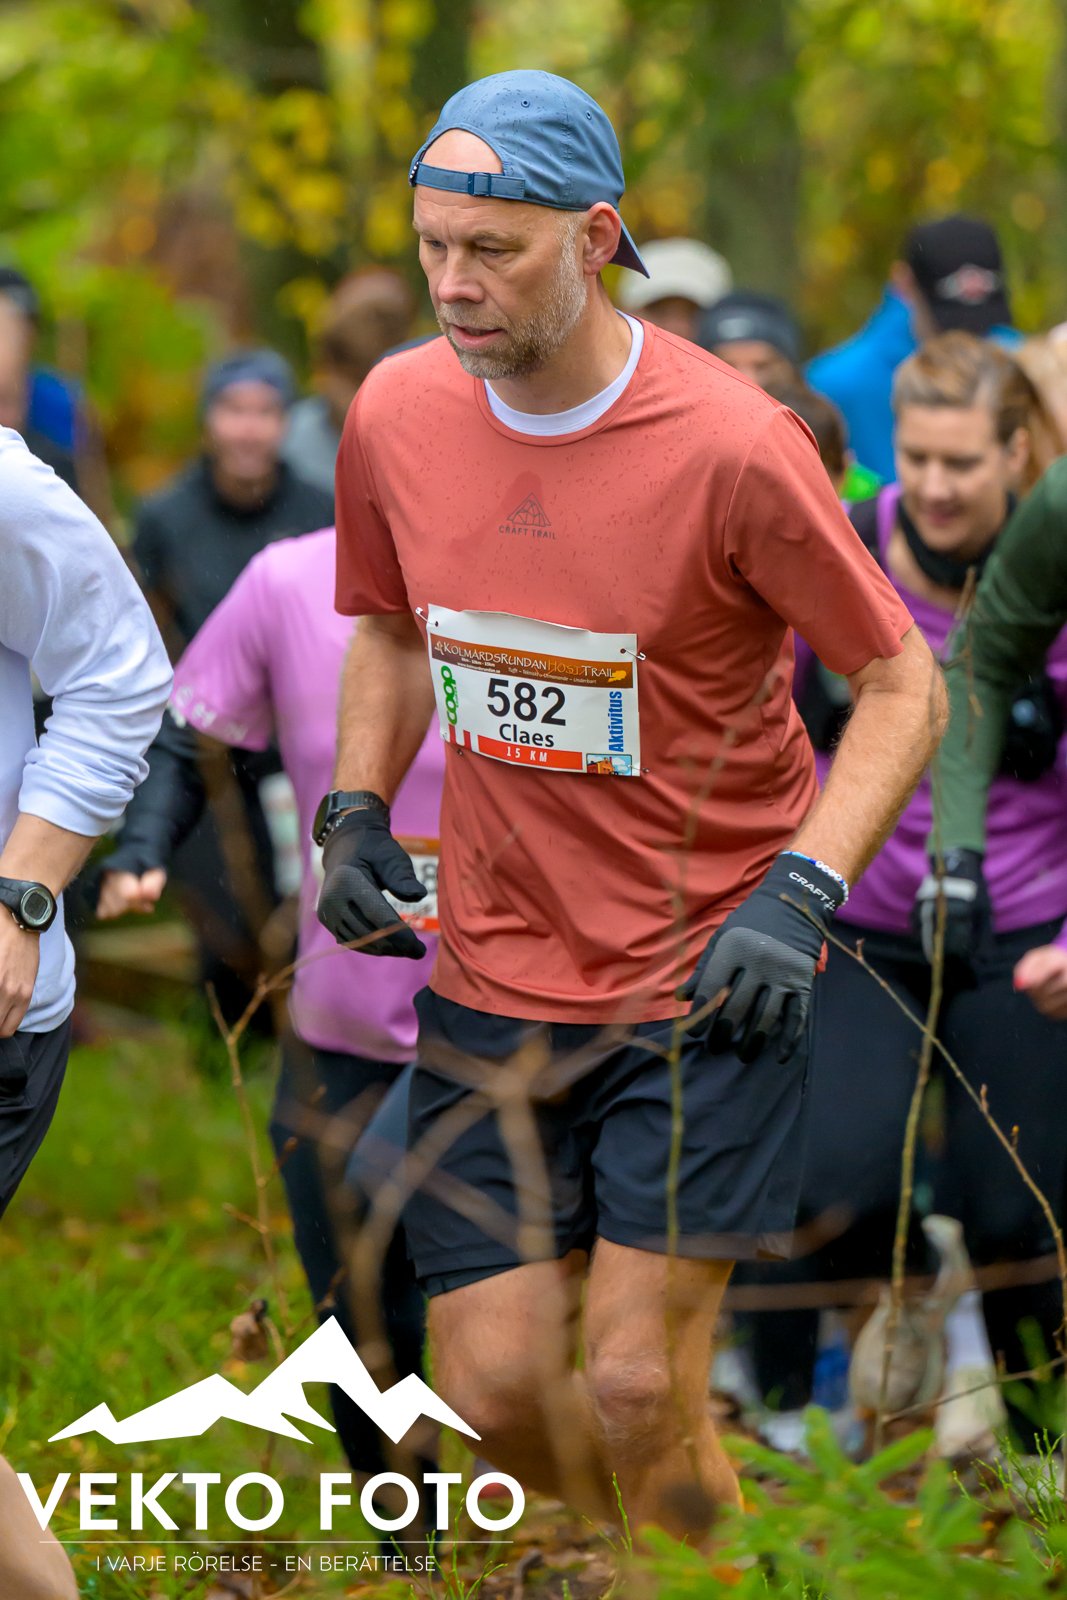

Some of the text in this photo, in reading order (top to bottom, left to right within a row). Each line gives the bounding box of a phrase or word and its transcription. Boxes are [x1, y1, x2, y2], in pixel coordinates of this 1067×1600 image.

[499, 525, 556, 540] CRAFT TRAIL
[441, 665, 457, 726] coop
[487, 677, 566, 727] 582
[499, 723, 554, 748] Claes
[608, 691, 624, 752] Aktivitus
[506, 746, 547, 762] 15 KM
[789, 872, 831, 901] CRAFT
